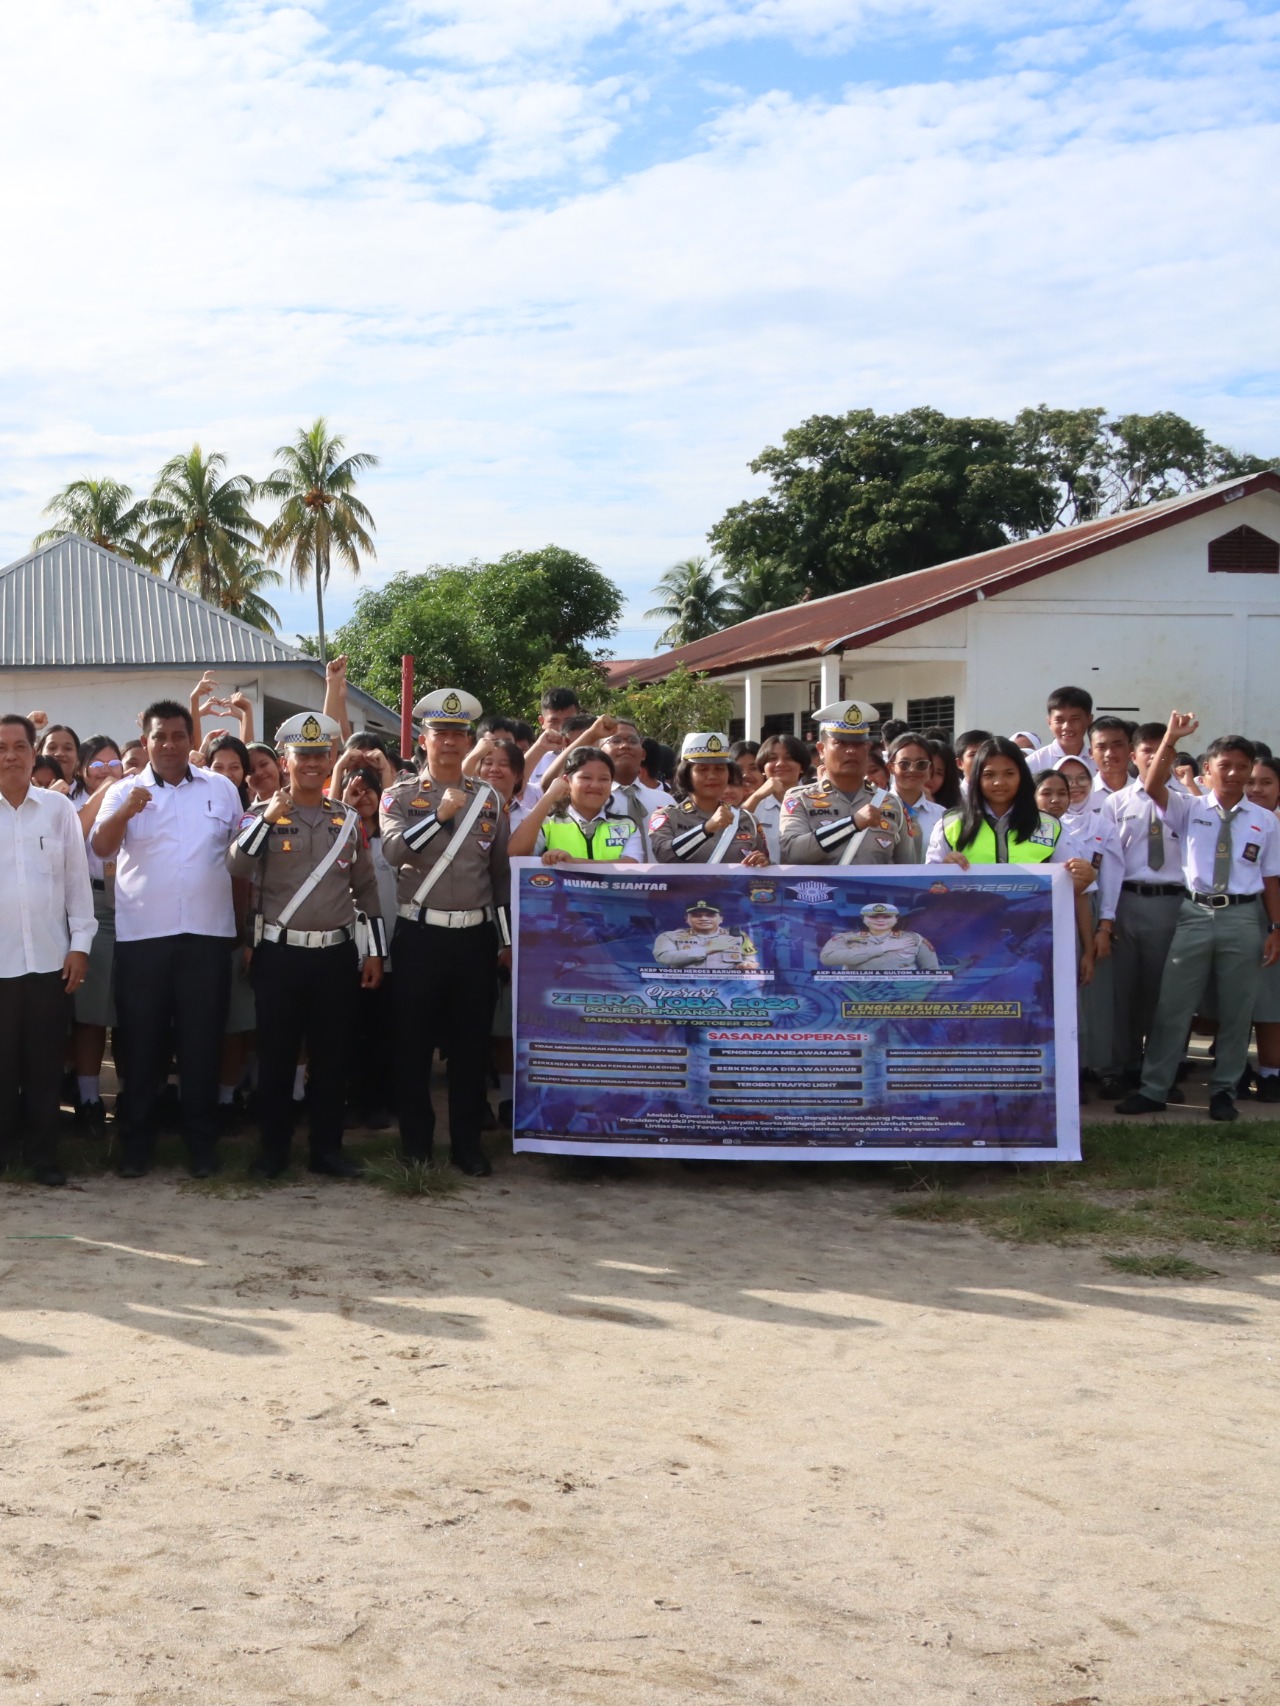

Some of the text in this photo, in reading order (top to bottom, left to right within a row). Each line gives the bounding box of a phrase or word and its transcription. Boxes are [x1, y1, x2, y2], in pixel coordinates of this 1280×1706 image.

[1030, 836, 1053, 847] PKS
[563, 879, 668, 891] HUMAS SIANTAR
[952, 884, 1039, 892] PRESISI
[552, 992, 800, 1010] ZEBRA TOBA 2024
[584, 1006, 770, 1017] POLRES PEMATANGSIANTAR
[708, 1032, 789, 1041] SASARAN
